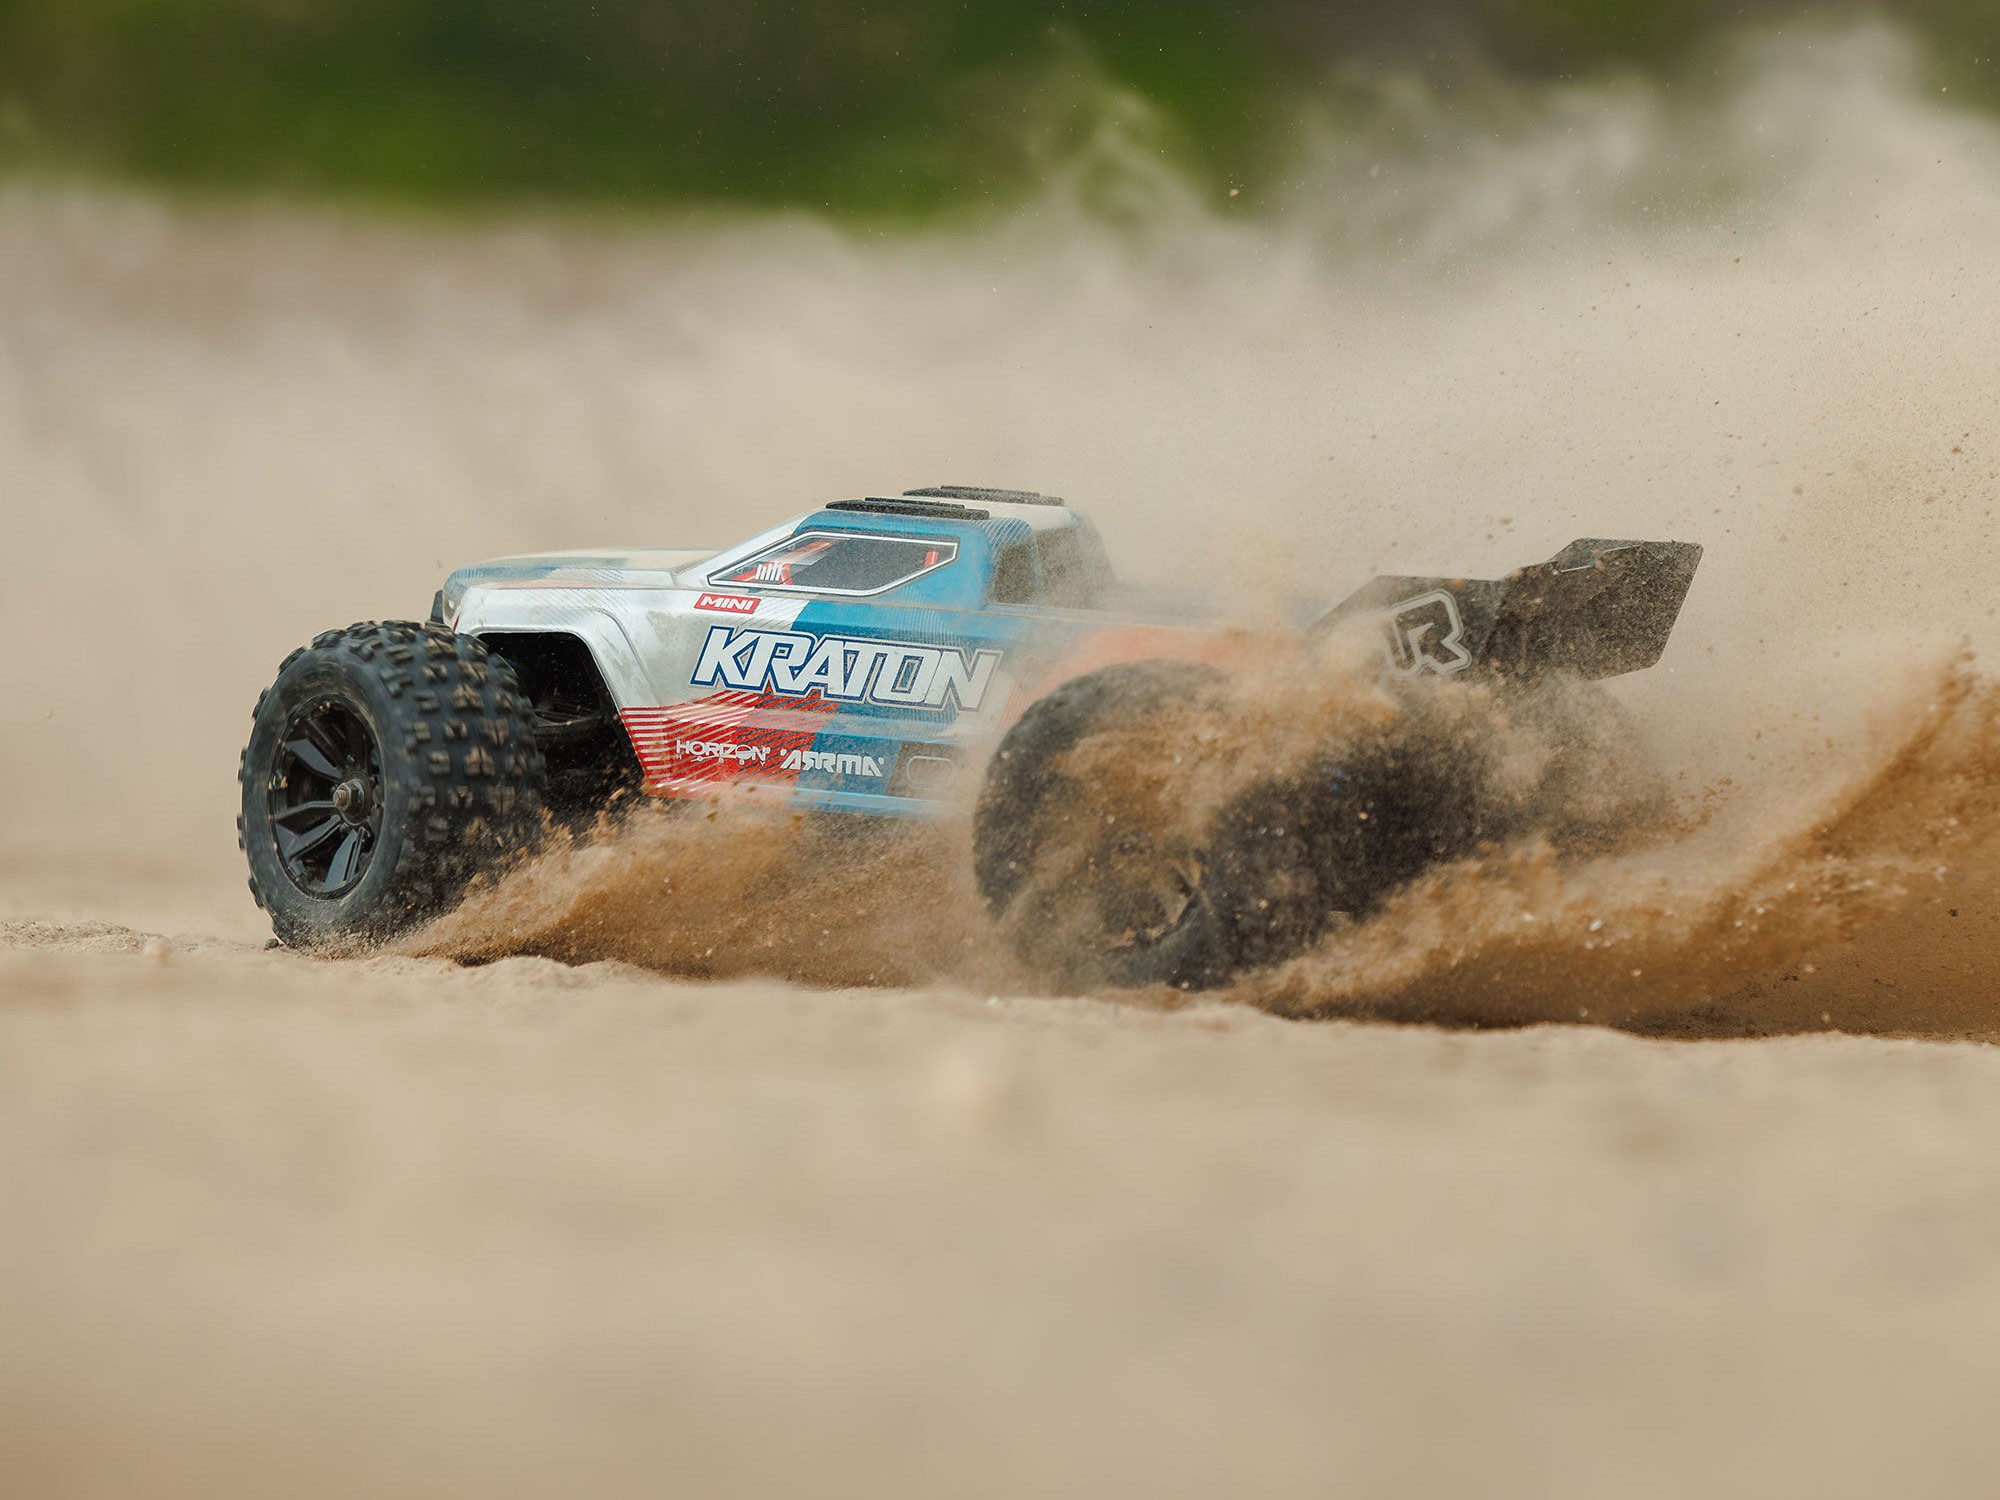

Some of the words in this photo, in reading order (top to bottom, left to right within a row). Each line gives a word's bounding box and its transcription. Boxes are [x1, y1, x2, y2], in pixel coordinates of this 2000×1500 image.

[700, 596, 755, 611] MINI
[690, 625, 1003, 713] KRATON
[676, 740, 765, 761] HORIZON
